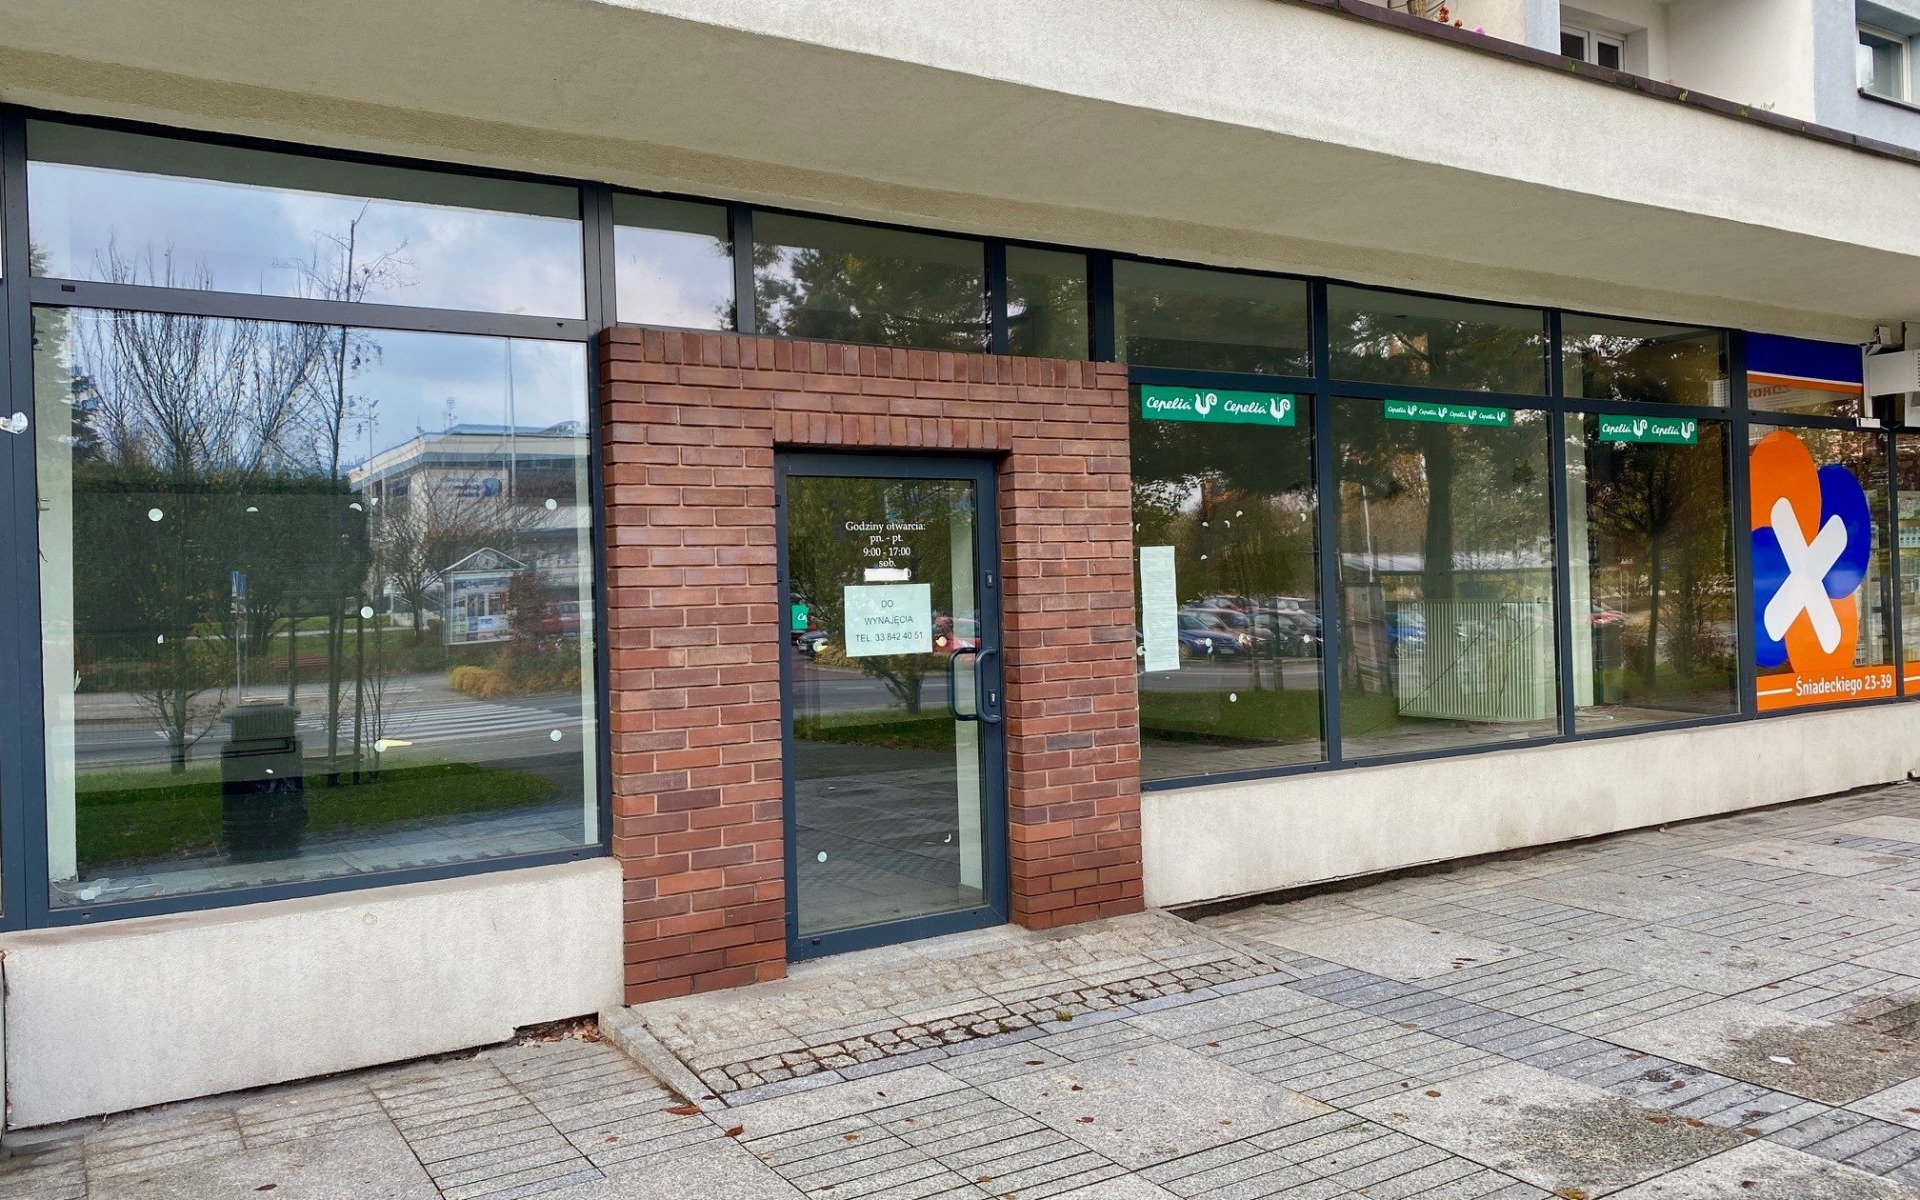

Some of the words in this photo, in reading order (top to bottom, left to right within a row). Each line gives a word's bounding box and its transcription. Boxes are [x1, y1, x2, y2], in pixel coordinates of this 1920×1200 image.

[1146, 396, 1193, 412] Cepelia
[1223, 400, 1268, 415] Cepelia
[1602, 423, 1631, 435] Cepelia
[1651, 425, 1679, 436] Cepelia
[845, 521, 884, 533] Godziny
[886, 521, 926, 531] otwarcia:
[870, 534, 884, 545] pn.
[892, 533, 904, 544] pt.
[863, 547, 881, 556] 9:00
[889, 547, 911, 556] 17:00
[878, 557, 896, 567] sob.
[881, 599, 894, 608] DO
[864, 615, 914, 626] WYNAJĘCIA
[875, 632, 885, 641] 33
[887, 631, 901, 640] 842
[903, 631, 912, 639] 40
[914, 631, 923, 639] 51
[1795, 675, 1862, 696] Śniadeckiego
[1865, 673, 1892, 690] 23-39
